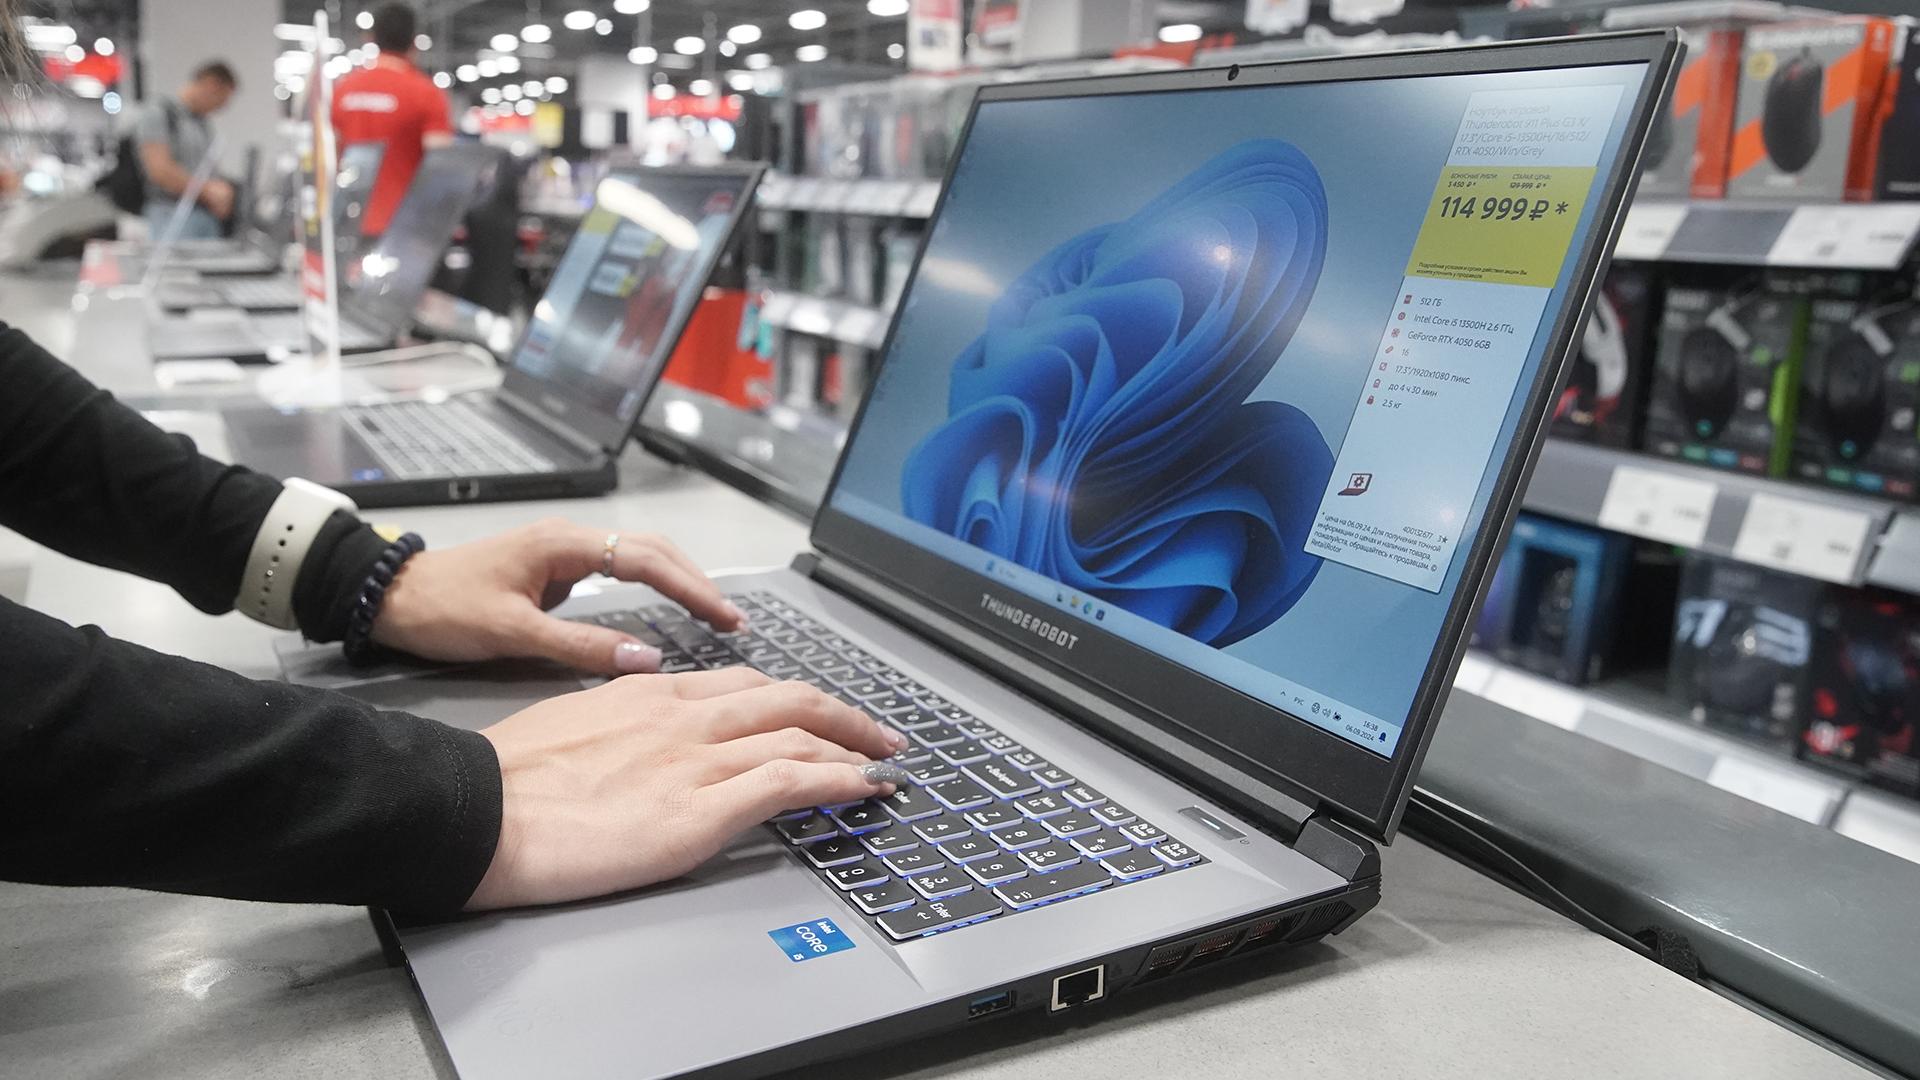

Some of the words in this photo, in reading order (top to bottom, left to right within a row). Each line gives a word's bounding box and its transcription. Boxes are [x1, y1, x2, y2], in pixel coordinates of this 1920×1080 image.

[1455, 146, 1471, 156] RTX
[1441, 196, 1477, 218] 114
[1480, 197, 1529, 221] 999
[1419, 297, 1432, 306] 512
[1432, 298, 1442, 308] ГБ
[1414, 314, 1431, 324] Intel
[1431, 316, 1450, 327] Core
[1450, 317, 1458, 327] i5
[1458, 319, 1486, 330] 13500H
[1487, 322, 1499, 332] 2.6
[1407, 331, 1437, 343] GeForce
[1437, 335, 1453, 345] RTX
[1454, 337, 1474, 348] 4050
[1474, 339, 1491, 350] 6GB
[1388, 384, 1399, 392] до
[1411, 385, 1421, 395] 30
[1421, 389, 1438, 398] мин
[1382, 399, 1393, 408] 2.5
[1317, 522, 1355, 538] информации
[1371, 528, 1384, 538] Для
[1385, 532, 1418, 546] получения
[1418, 539, 1442, 553] точной
[980, 593, 1079, 650] THUNDEROBOT
[1345, 724, 1375, 741] 06.09.2024
[1363, 720, 1378, 732] 16:38
[929, 902, 951, 918] Enter
[817, 921, 836, 934] intel
